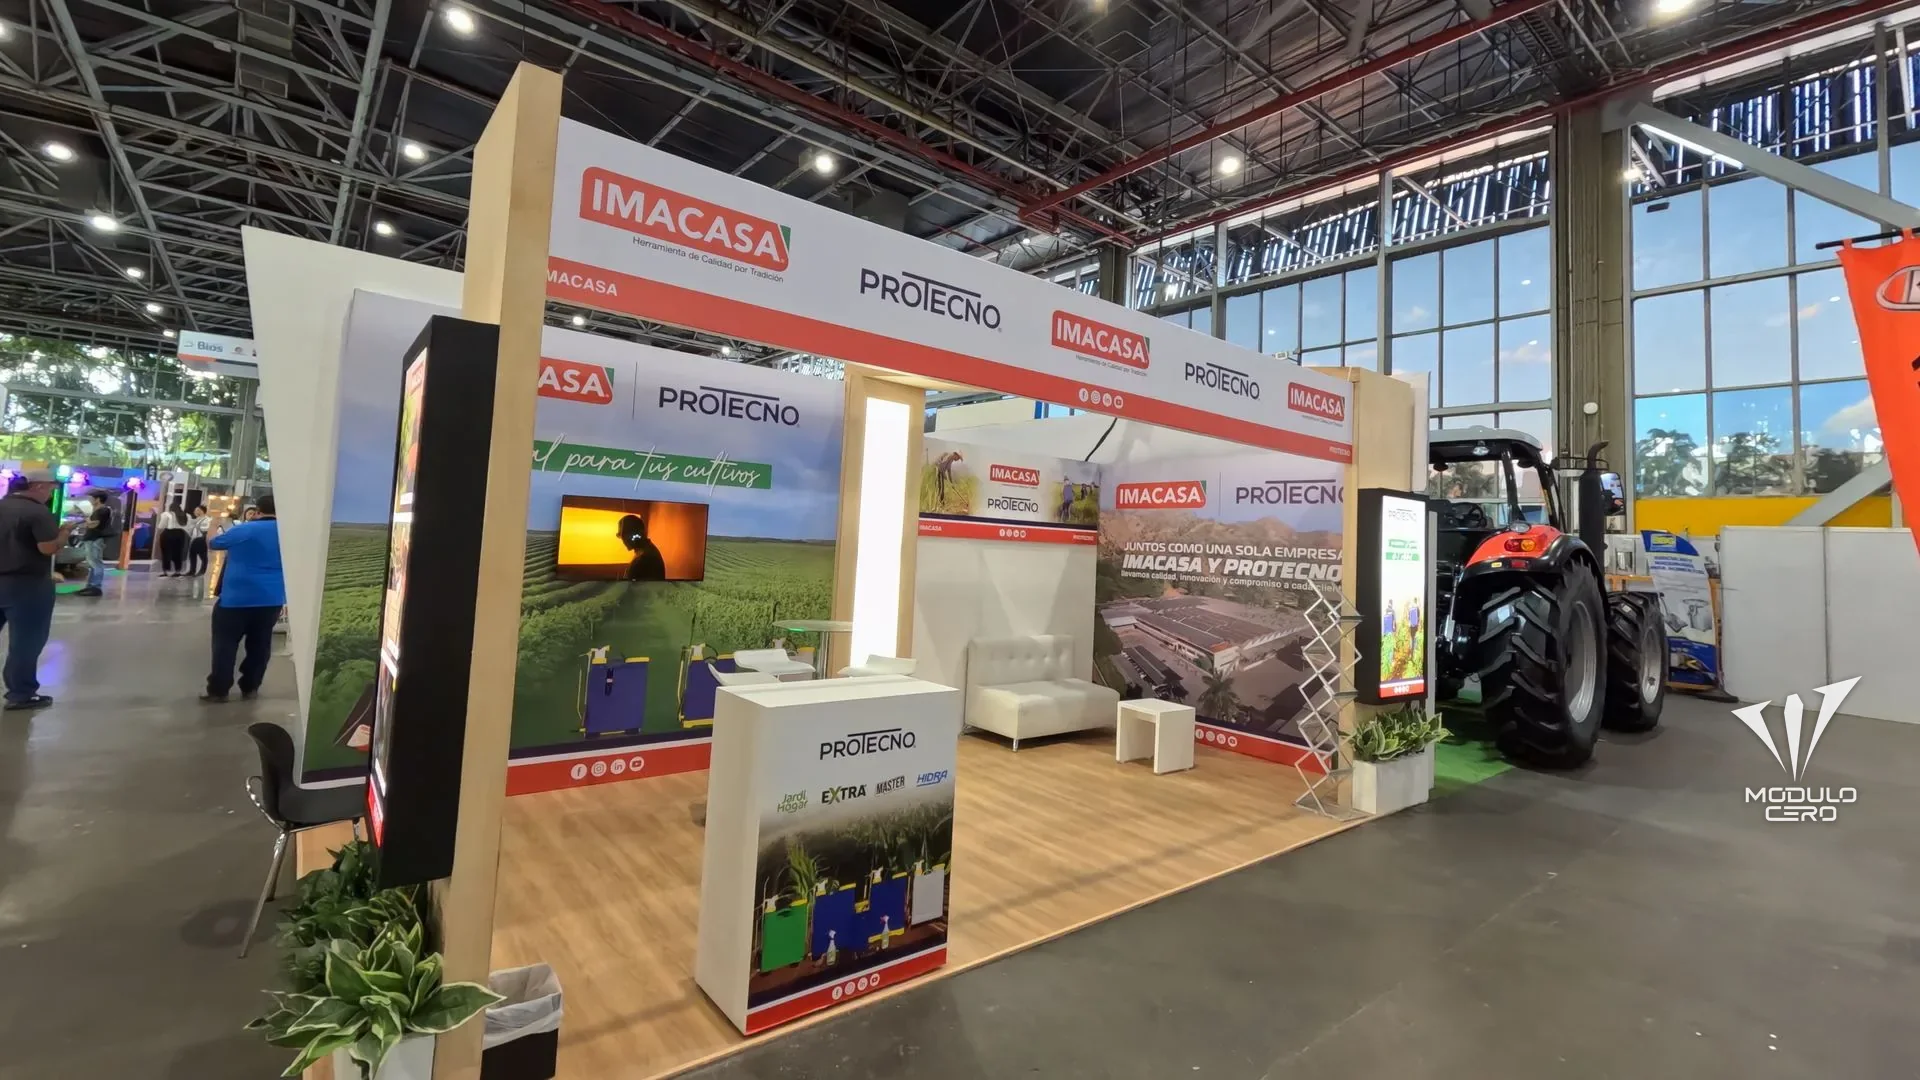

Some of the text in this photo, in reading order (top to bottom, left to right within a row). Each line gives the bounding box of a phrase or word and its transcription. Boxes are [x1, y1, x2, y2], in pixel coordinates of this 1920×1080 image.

[592, 178, 781, 263] IMACASA
[632, 236, 784, 283] Herramienta de Calidad por Tradición
[546, 268, 617, 296] MACASA
[860, 268, 1001, 329] PROTECNO
[197, 341, 224, 353] Bios
[1056, 317, 1147, 363] IMACASA
[1185, 362, 1260, 400] PROTECNO
[659, 385, 800, 427] PROTECNO
[1290, 387, 1342, 417] IMACASA
[558, 452, 636, 482] para
[634, 445, 678, 491] tus
[683, 450, 760, 496] cultivos
[992, 467, 1038, 483] IMACASA
[987, 496, 1039, 513] PROTECNO
[1119, 486, 1201, 504] IMACASA
[1124, 541, 1166, 553] JUNTOS
[1168, 544, 1204, 555] COMO
[1206, 545, 1234, 556] UNA
[1235, 545, 1272, 557] SOLA
[1122, 554, 1343, 582] IMACASA Y PROTECNO
[1180, 574, 1220, 584] innovación
[1223, 577, 1229, 585] y
[1229, 578, 1282, 589] compromiso
[820, 728, 916, 760] PROTECNO
[876, 776, 905, 794] MASTER
[917, 770, 948, 787] HIDRA
[822, 785, 866, 804] EXTRA
